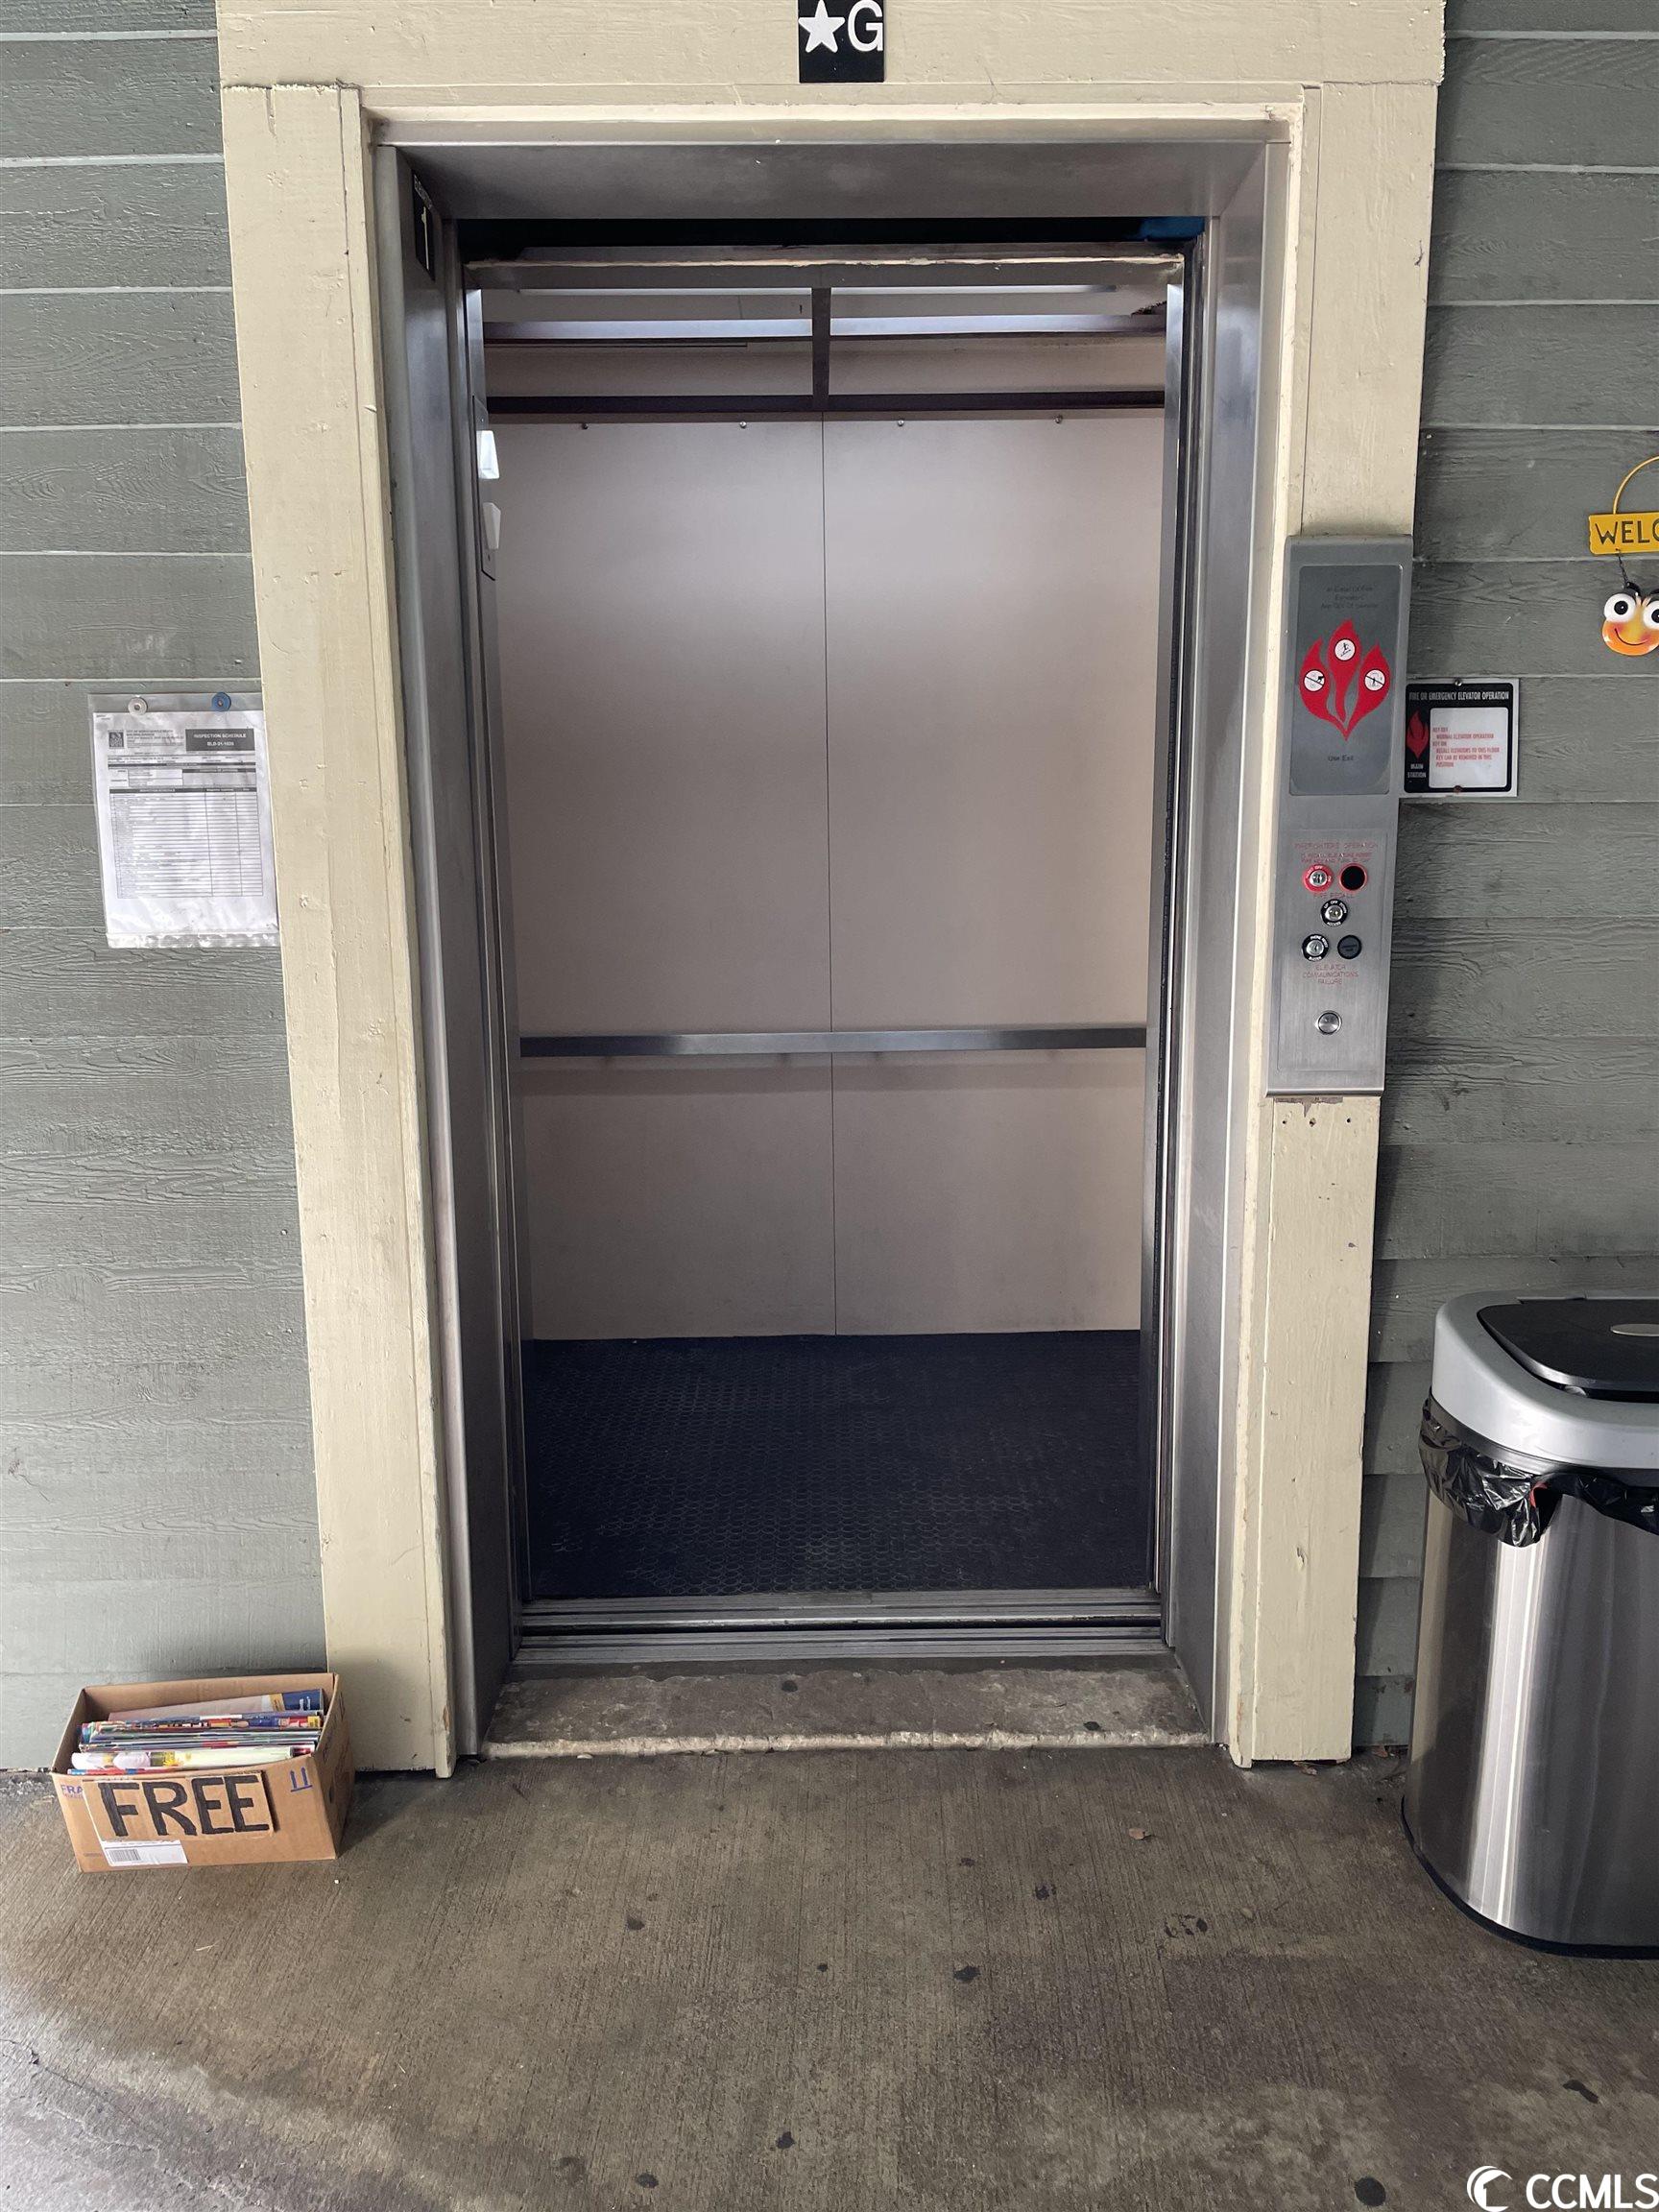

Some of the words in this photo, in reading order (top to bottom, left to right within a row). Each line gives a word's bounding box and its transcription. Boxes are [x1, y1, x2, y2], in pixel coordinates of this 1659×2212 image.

[848, 0, 883, 51] G
[1458, 691, 1481, 700] ELEVATOR
[1481, 691, 1509, 700] OPERATION
[1338, 902, 1347, 914] DOWN
[98, 1775, 270, 1836] FREE
